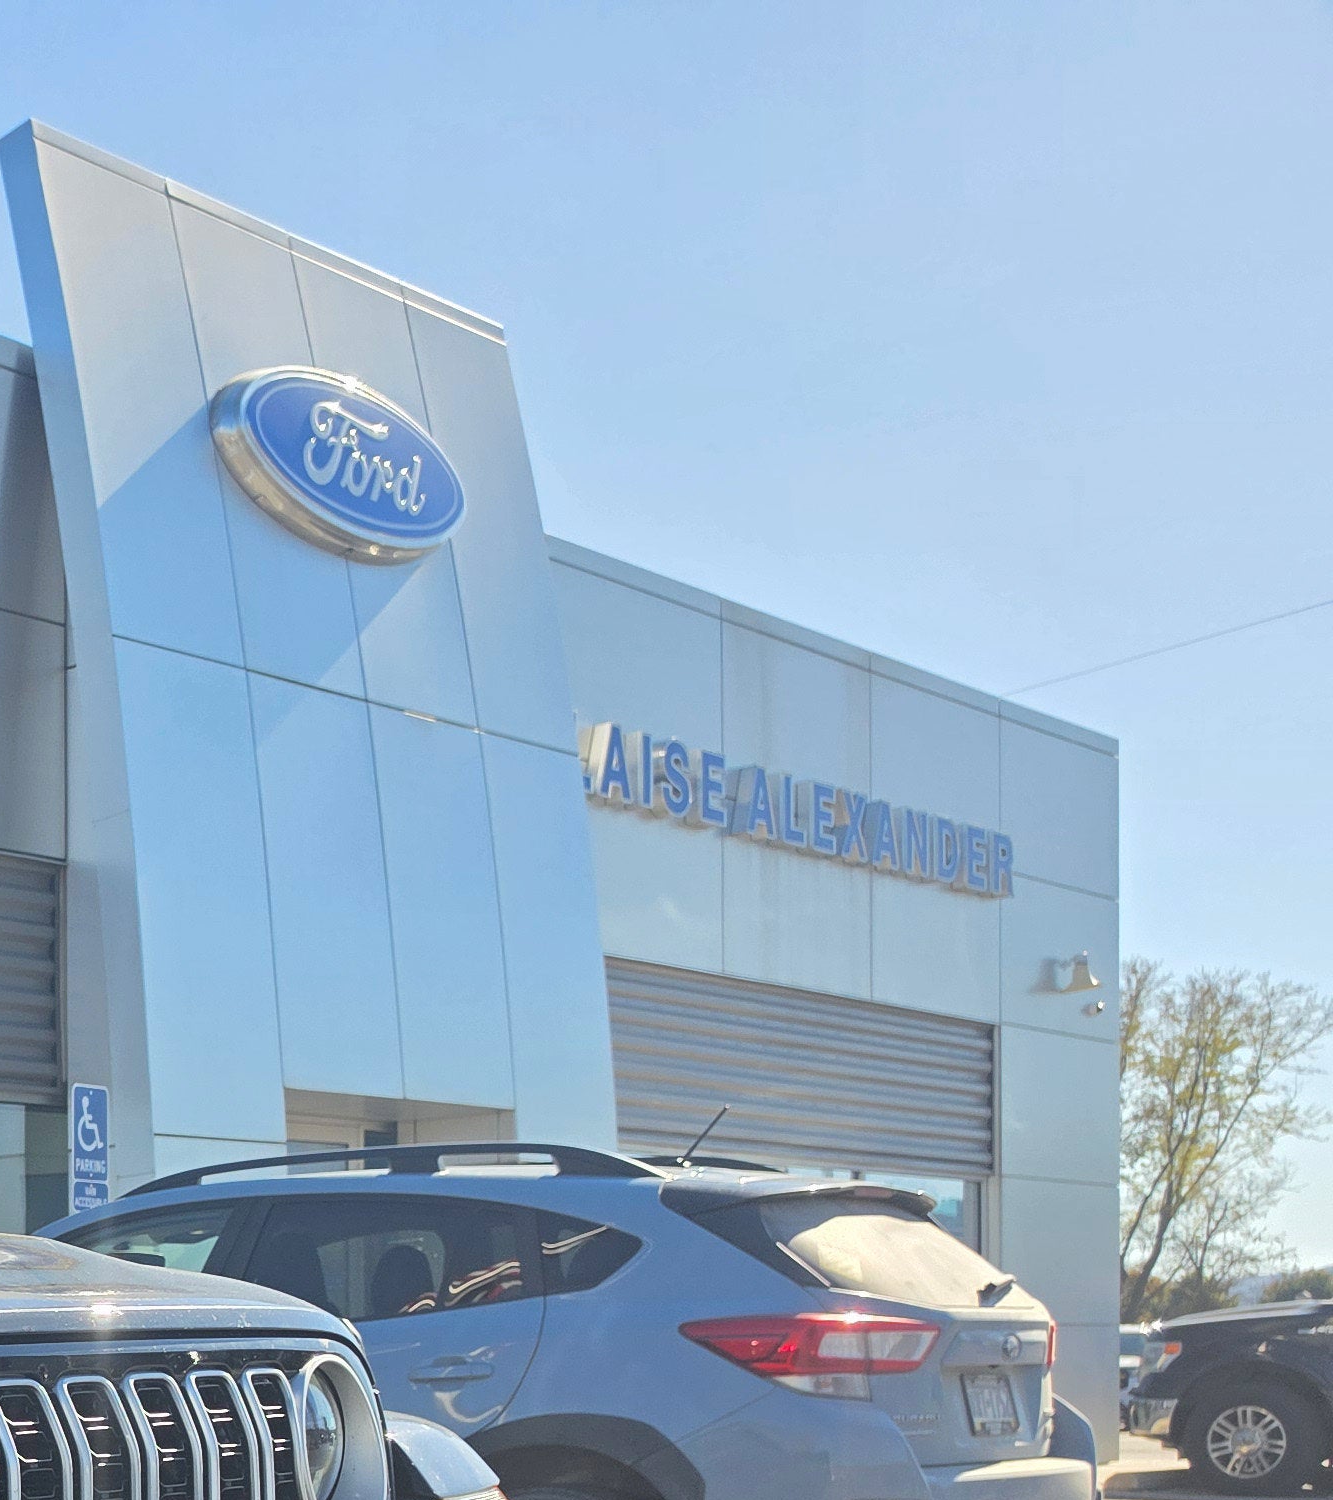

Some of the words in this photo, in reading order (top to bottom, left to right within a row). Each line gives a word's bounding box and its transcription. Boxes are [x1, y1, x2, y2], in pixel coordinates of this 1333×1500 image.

[303, 400, 426, 516] Ford
[583, 721, 728, 829] AISE
[745, 765, 1014, 898] ALEXANDER
[75, 1157, 106, 1174] PARKING
